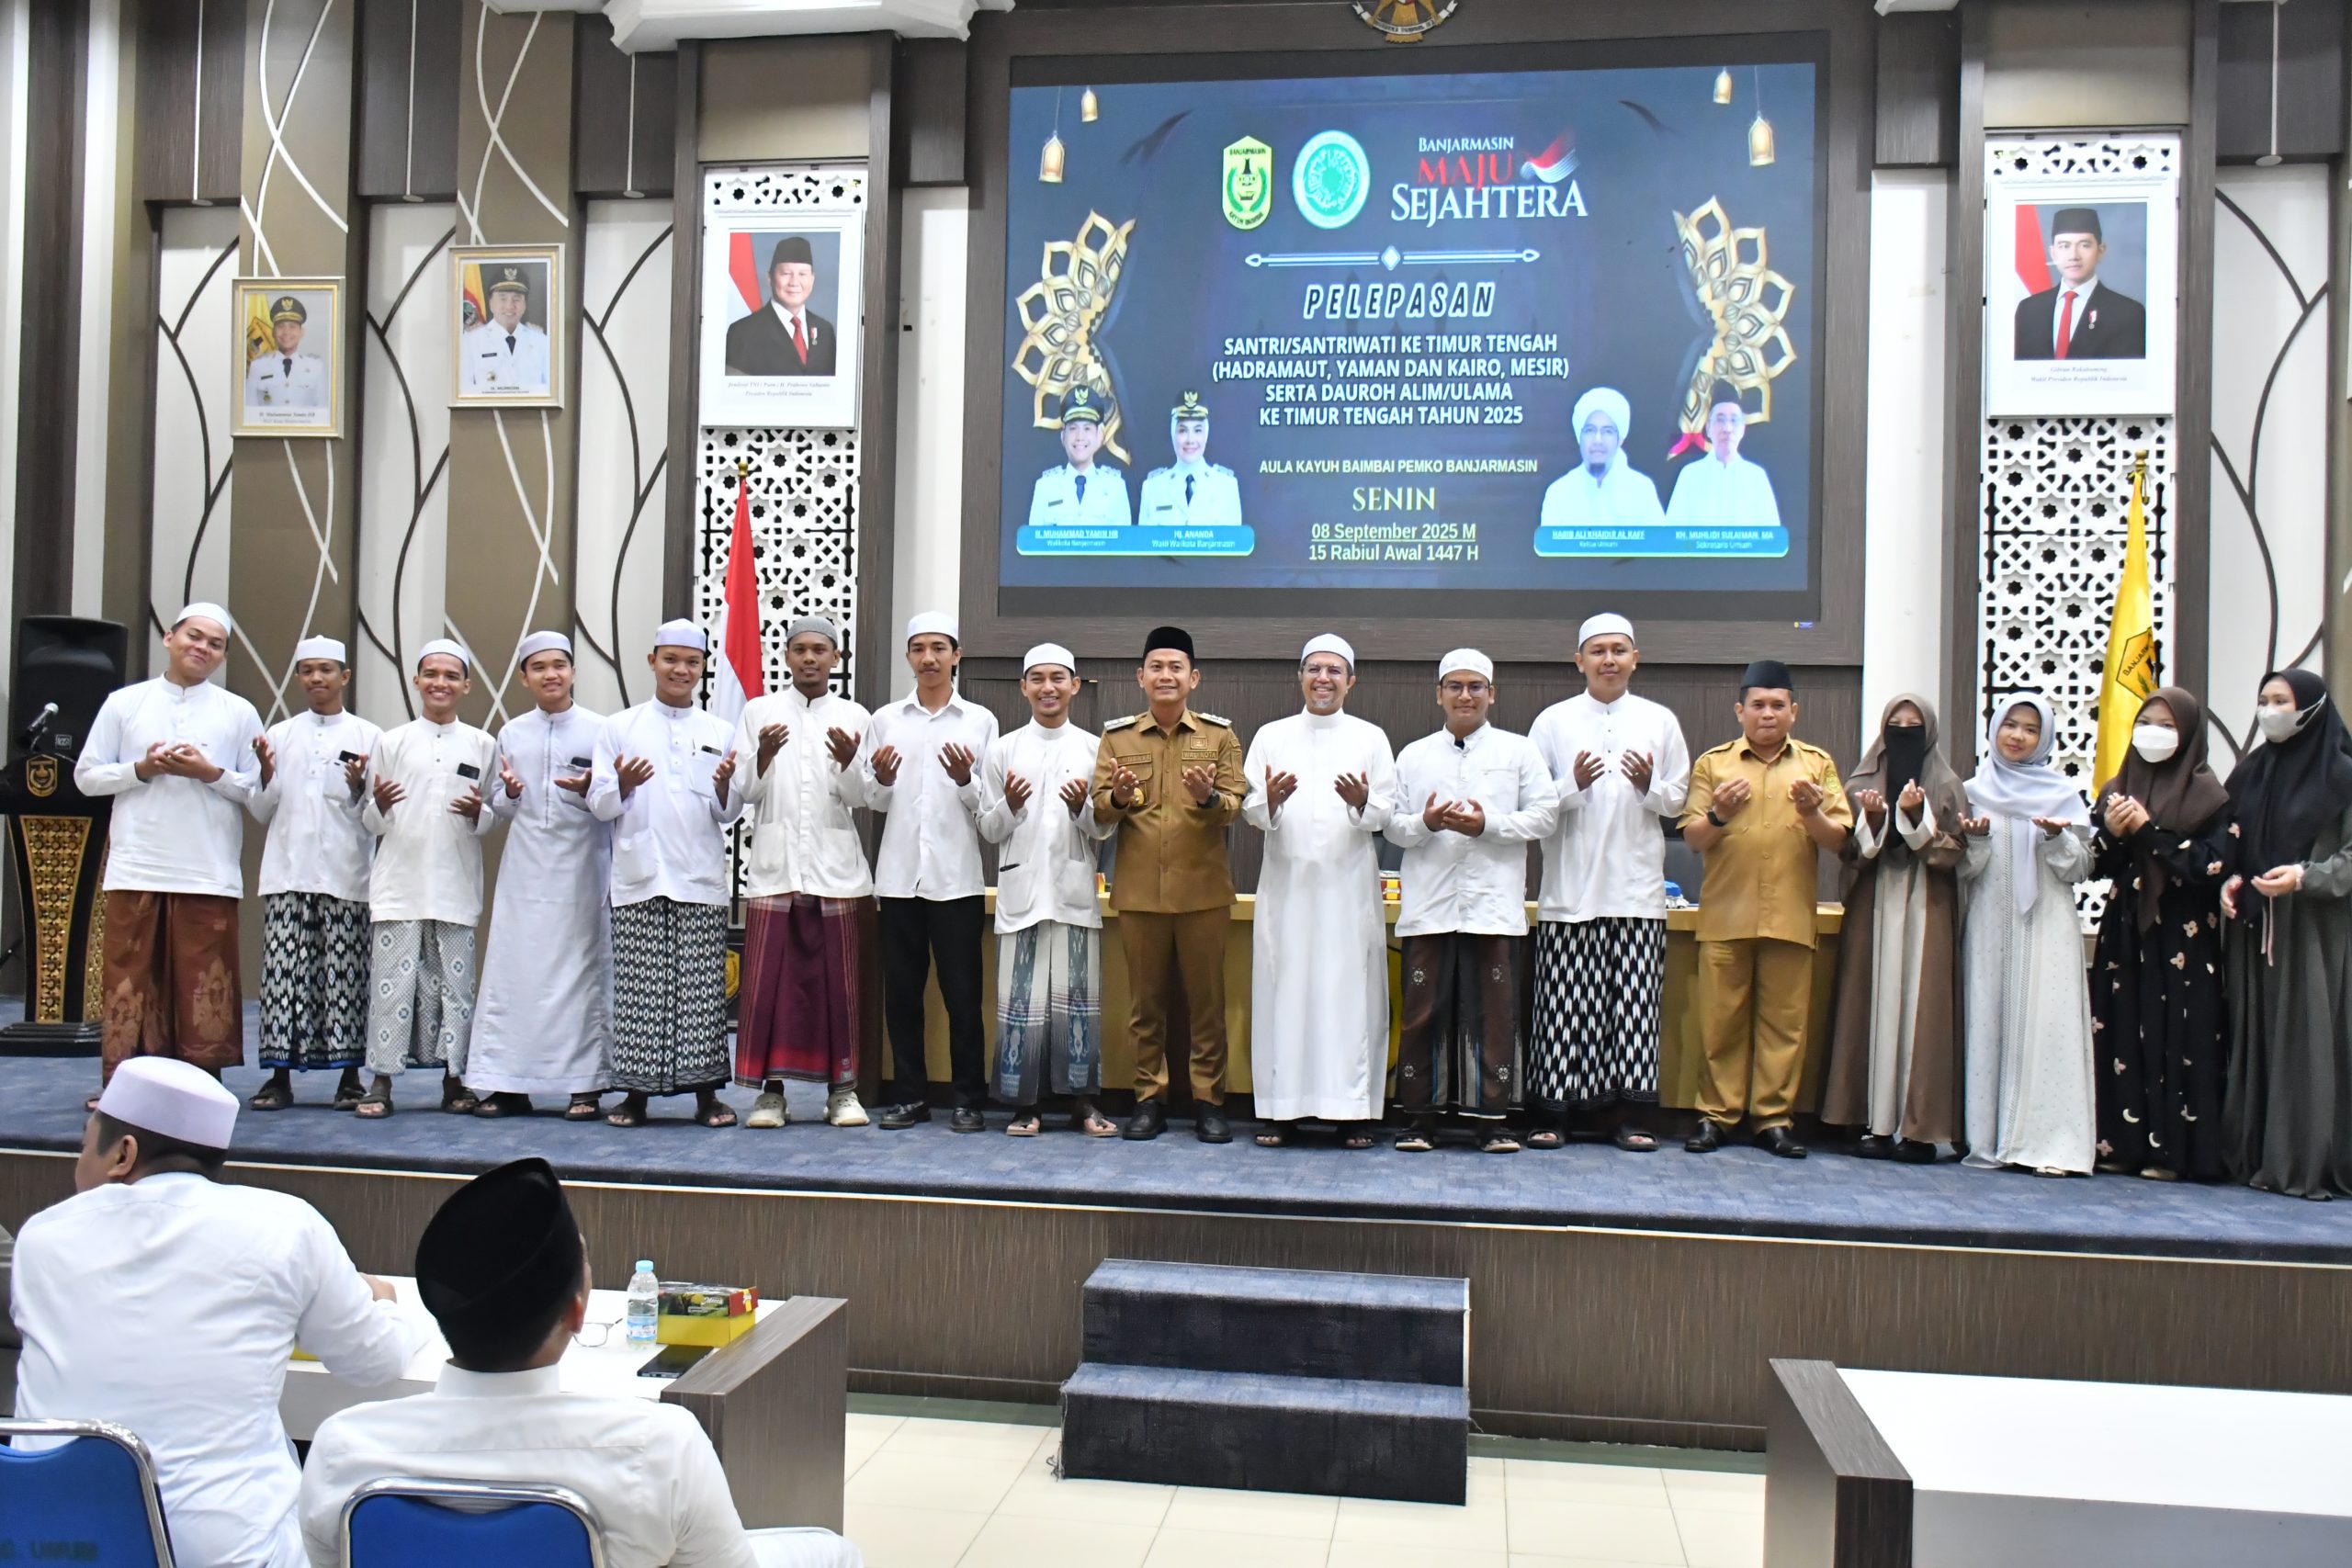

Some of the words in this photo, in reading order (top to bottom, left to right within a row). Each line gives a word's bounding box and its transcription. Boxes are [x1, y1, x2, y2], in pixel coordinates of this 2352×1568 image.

[1419, 136, 1513, 153] BANJARMASIN
[1418, 152, 1512, 191] MAJU
[1391, 179, 1589, 228] SEJAHTERA
[1303, 282, 1496, 319] PELEPASAN
[1225, 336, 1396, 355] SANTRI/SANTRIWATI
[1401, 335, 1421, 353] KE
[1426, 335, 1482, 353] TIMUR
[1486, 334, 1557, 352] TENGAH
[1212, 360, 1331, 382] (HADRAMAUT,
[1336, 359, 1400, 378] YAMAN
[1405, 359, 1442, 377] DAN
[1447, 358, 1505, 379] KAIRO,
[1510, 357, 1569, 378] MESIR)
[1265, 384, 1317, 402] SERTA
[1321, 383, 1396, 401] DAUROH
[1399, 382, 1513, 401] ALIM/ULAMA
[1260, 407, 1280, 425] KE
[1283, 407, 1340, 425] TIMUR
[1343, 406, 1413, 425] TENGAH
[1418, 406, 1479, 424] TAHUN
[1483, 406, 1523, 424] 2025
[1259, 460, 1294, 474] AULA
[1296, 460, 1340, 474] KAYUH
[1342, 459, 1395, 473] BAIMBAI
[1397, 459, 1443, 473] PEMKO
[1445, 458, 1538, 473] BANJARMASIN
[1352, 486, 1436, 512] SENIN
[1311, 523, 1331, 539] 08
[1334, 522, 1418, 543] September
[1421, 523, 1459, 539] 2025
[1462, 523, 1476, 539] M
[1308, 544, 1328, 560] 15
[1330, 543, 1379, 560] Rabiul
[1384, 544, 1422, 561] Awal
[1426, 544, 1463, 560] 1447
[1467, 544, 1478, 560] H
